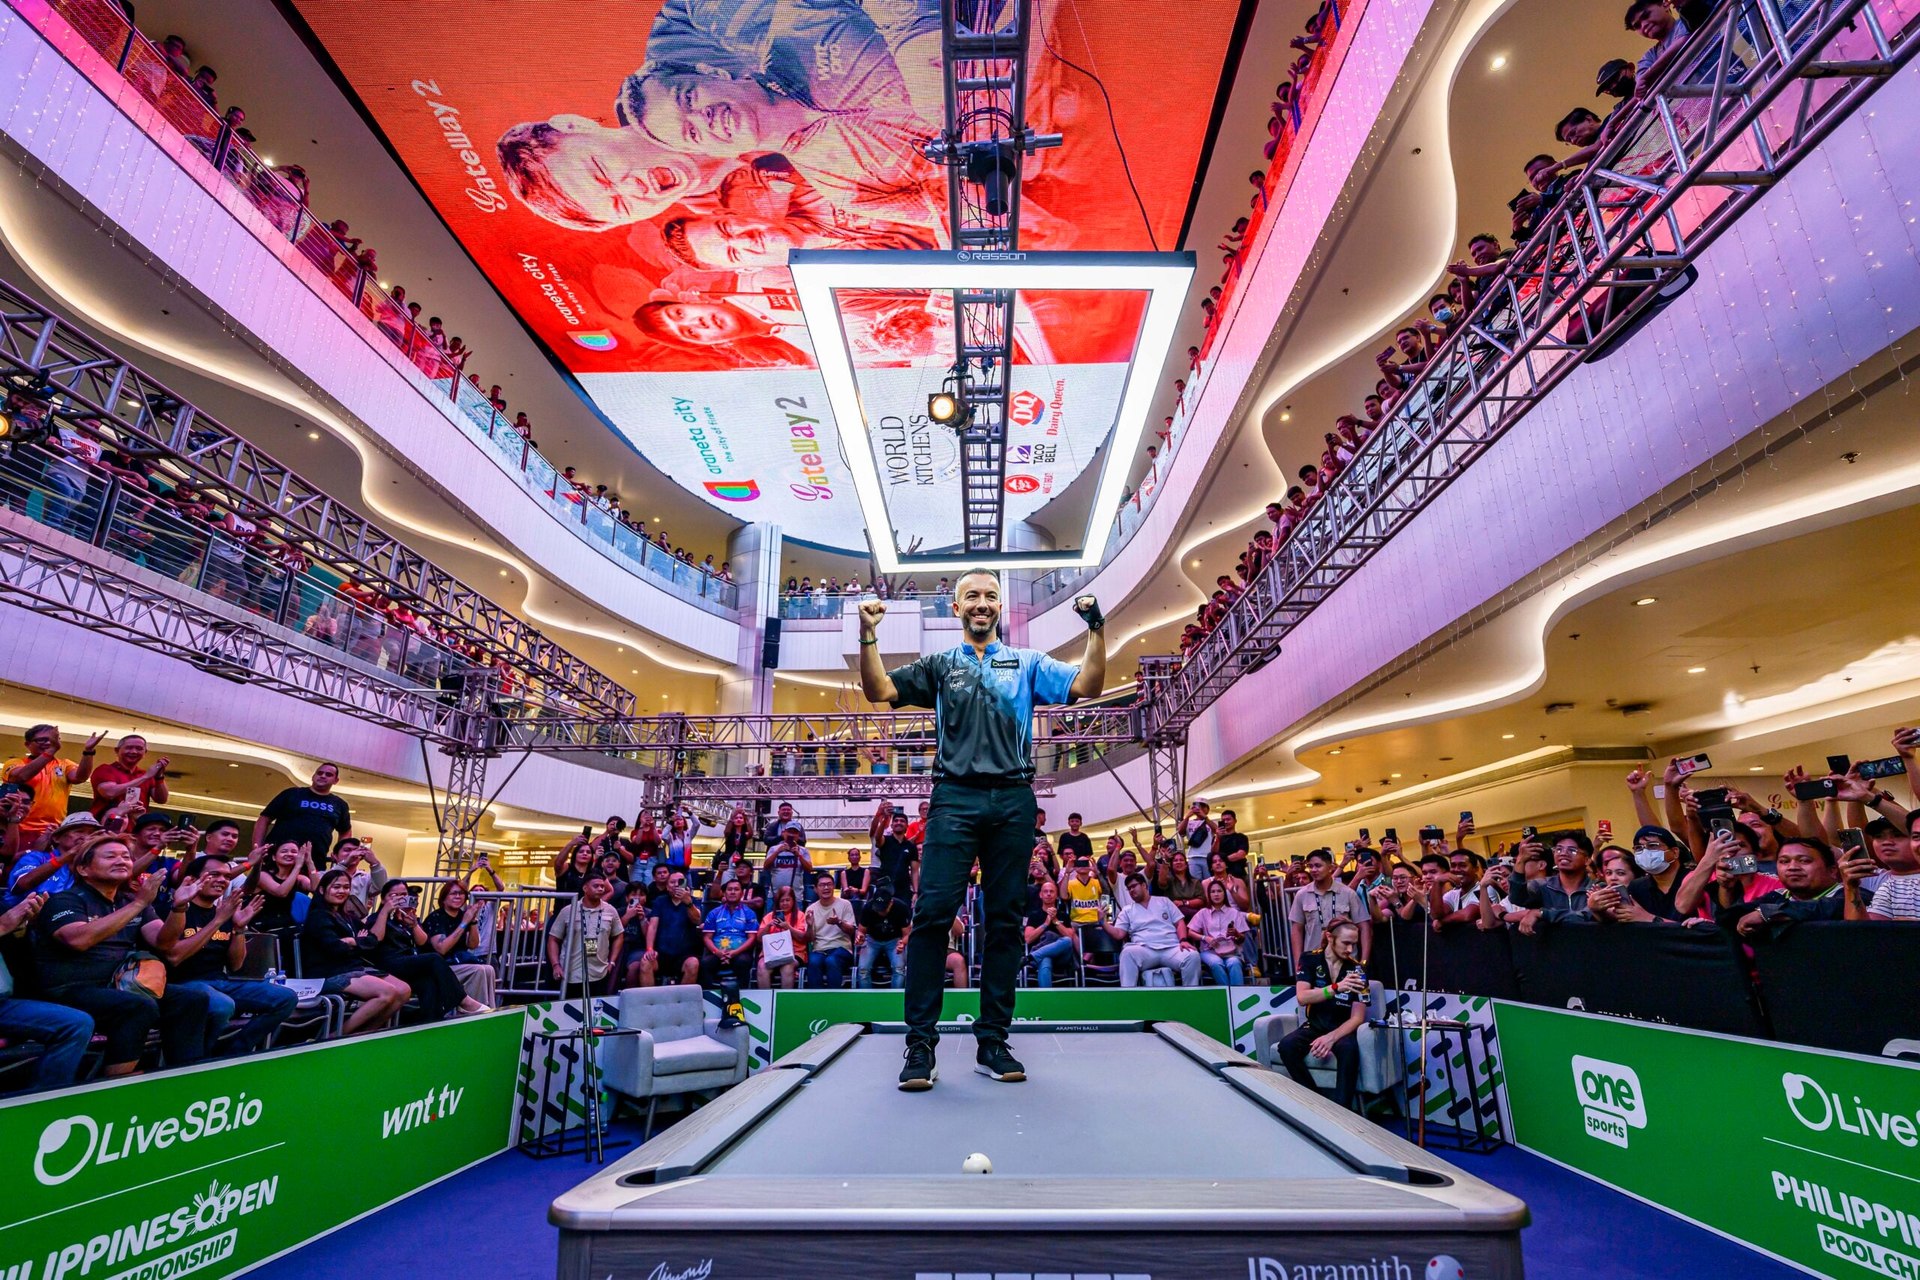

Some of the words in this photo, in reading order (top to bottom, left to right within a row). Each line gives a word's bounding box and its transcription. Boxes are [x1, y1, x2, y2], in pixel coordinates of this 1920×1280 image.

[411, 78, 443, 97] 2
[426, 99, 507, 213] Gateway
[517, 252, 545, 280] city
[540, 283, 580, 326] araneta
[671, 396, 697, 423] city
[774, 396, 808, 409] 2
[1012, 395, 1038, 420] DQ
[1046, 411, 1063, 436] Dairy
[689, 427, 722, 475] araneta
[785, 413, 834, 501] Gateway
[880, 416, 911, 486] WORLD
[909, 414, 934, 486] KITCHENS
[1033, 443, 1045, 464] TACO
[1044, 444, 1057, 463] BELL
[300, 799, 335, 813] BOSS
[1581, 1070, 1636, 1112] one
[381, 1083, 465, 1139] wnt.tv
[1586, 1115, 1625, 1139] sports
[1831, 1092, 1920, 1148] Live
[0, 1206, 190, 1280] IPPINES
[1822, 1232, 1882, 1269] POOL
